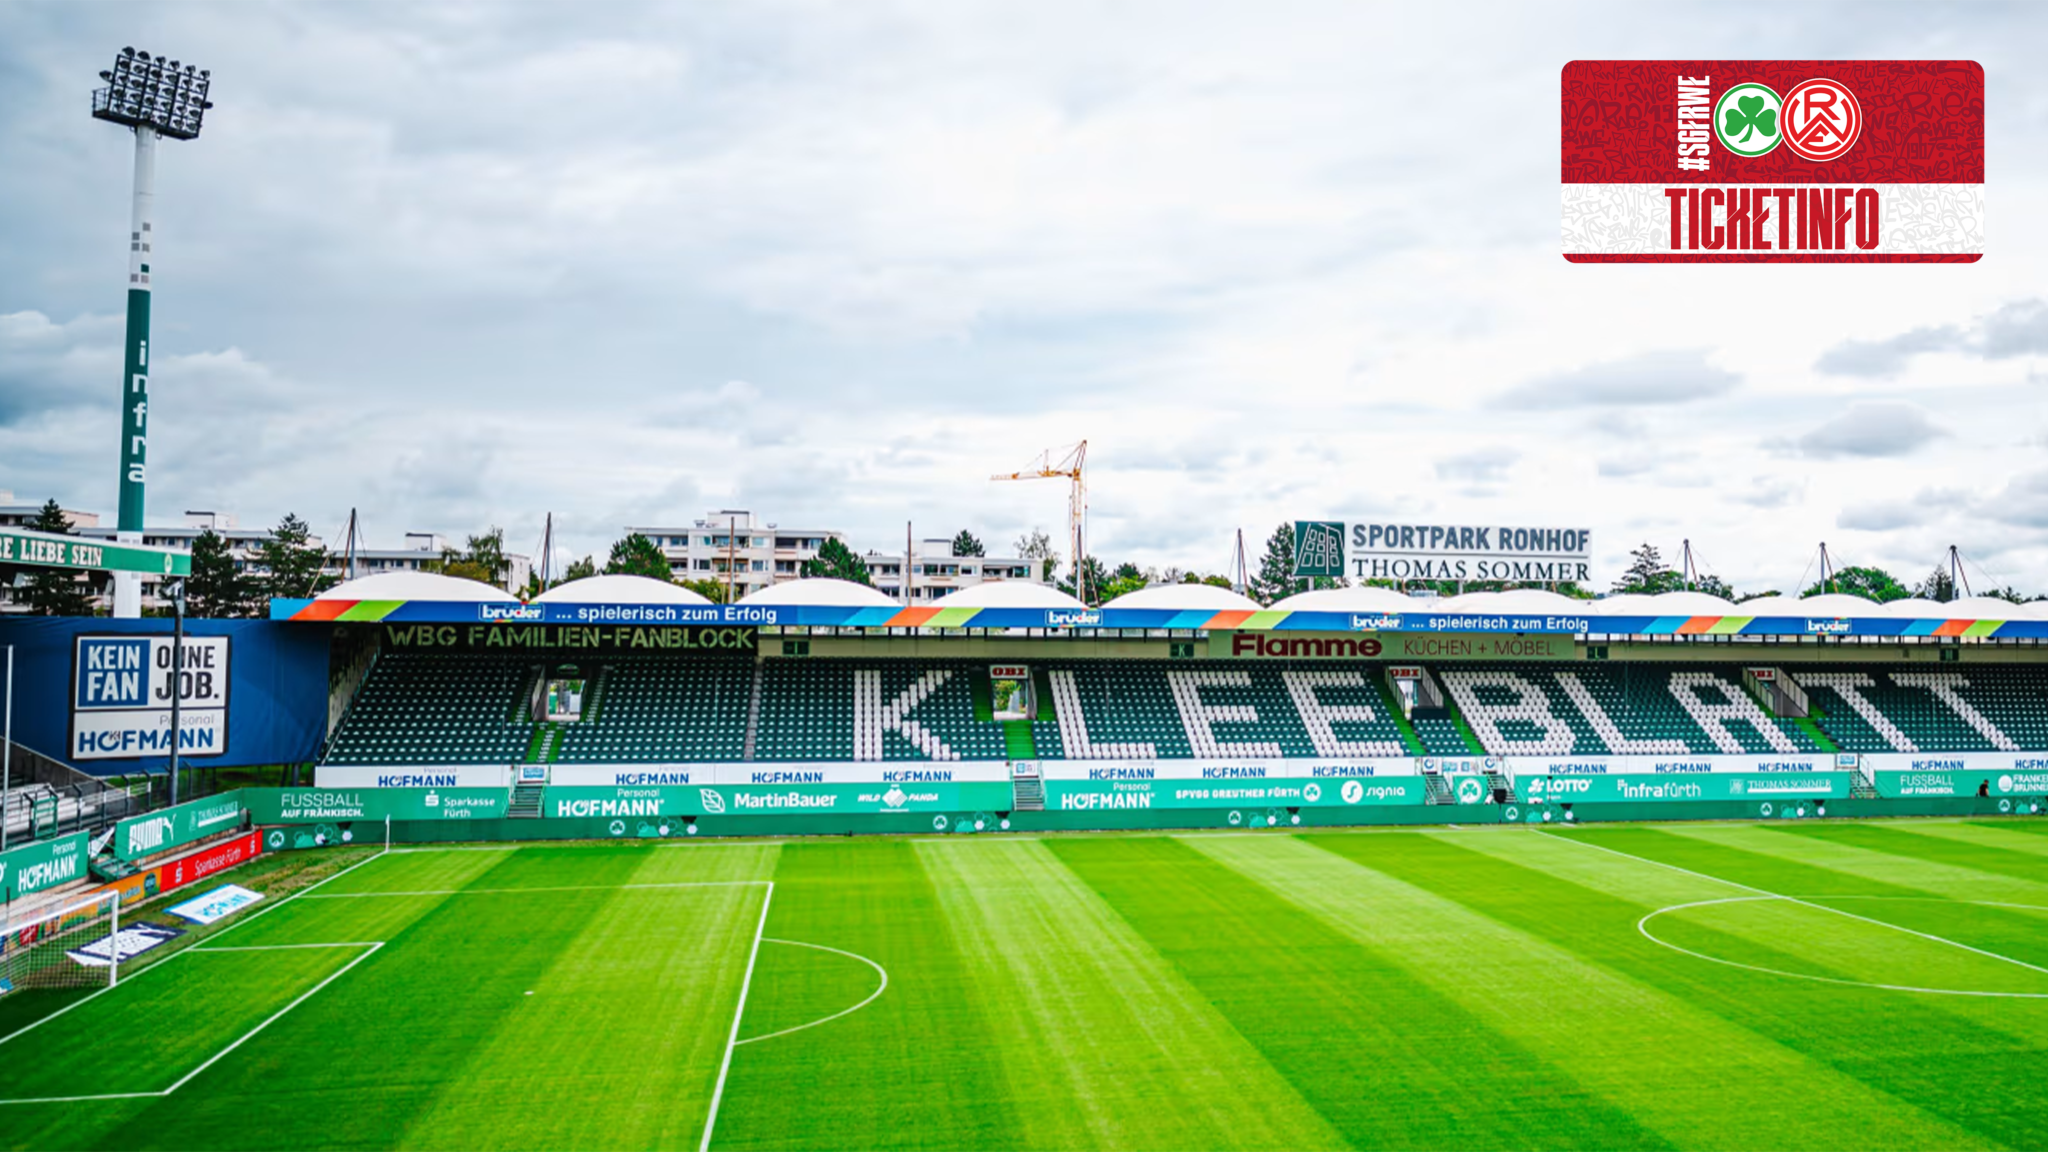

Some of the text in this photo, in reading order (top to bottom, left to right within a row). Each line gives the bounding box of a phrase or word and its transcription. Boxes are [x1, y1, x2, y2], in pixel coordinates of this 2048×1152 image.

[127, 340, 148, 483] infra
[1352, 524, 1590, 552] SPORTPARK RONHOF
[20, 538, 66, 564] LIEBE
[71, 544, 103, 567] SEIN
[1352, 558, 1591, 581] THOMAS SOMMER
[481, 604, 542, 620] bruder
[578, 606, 675, 622] spielerisch
[682, 609, 718, 620] zum
[725, 607, 777, 624] Erfolg
[1048, 610, 1100, 624] bruder
[1353, 614, 1400, 629] bruder
[1429, 616, 1508, 631] spielerisch
[1512, 620, 1542, 630] zum
[1546, 617, 1589, 632] Erfolg
[1808, 619, 1850, 633] bruder
[387, 625, 754, 648] WBG FAMILIEN-FANBLOCK
[1232, 634, 1383, 656] Flamme
[1404, 636, 1473, 656] KÜCHEN
[1494, 636, 1555, 656] MÖBEL
[87, 645, 141, 670] KEIN
[992, 667, 1026, 677] OBI
[87, 671, 220, 702] FAN JOB.
[159, 714, 215, 726] Pesonal
[78, 728, 214, 752] HOFMANN
[1549, 764, 1607, 774] HOFMANN
[1656, 763, 1711, 773] HOFMANN
[1758, 762, 1813, 772] HOFMANN
[1912, 760, 1964, 770] HOFMANN
[752, 772, 823, 783] HOFMANN
[883, 771, 951, 782] HOFMANN
[1089, 768, 1155, 780] HOFMANN
[1203, 767, 1266, 778] HOFMANN
[1312, 766, 1374, 777] HOFMANN
[378, 775, 456, 787] HOFMANN
[616, 773, 689, 785] HOFMANN
[1747, 779, 1832, 790] THOMAS SOMMER
[1900, 774, 1954, 786] FUSSBALL
[1113, 782, 1150, 791] Personal
[1547, 779, 1590, 792] LOTTO
[617, 788, 660, 798] Personal
[1212, 788, 1265, 798] GREUTHER
[1267, 786, 1300, 798] FÜRTH
[1366, 786, 1406, 800] signia
[281, 793, 364, 807] FUSSBALL
[444, 797, 496, 807] Sparkasse
[734, 792, 837, 809] MartinBauer
[1062, 793, 1150, 809] HOFMANN
[281, 809, 300, 818] AUF
[444, 808, 471, 817] Fürth
[558, 799, 660, 817] HOFMANN
[18, 855, 76, 892] HOFMANN
